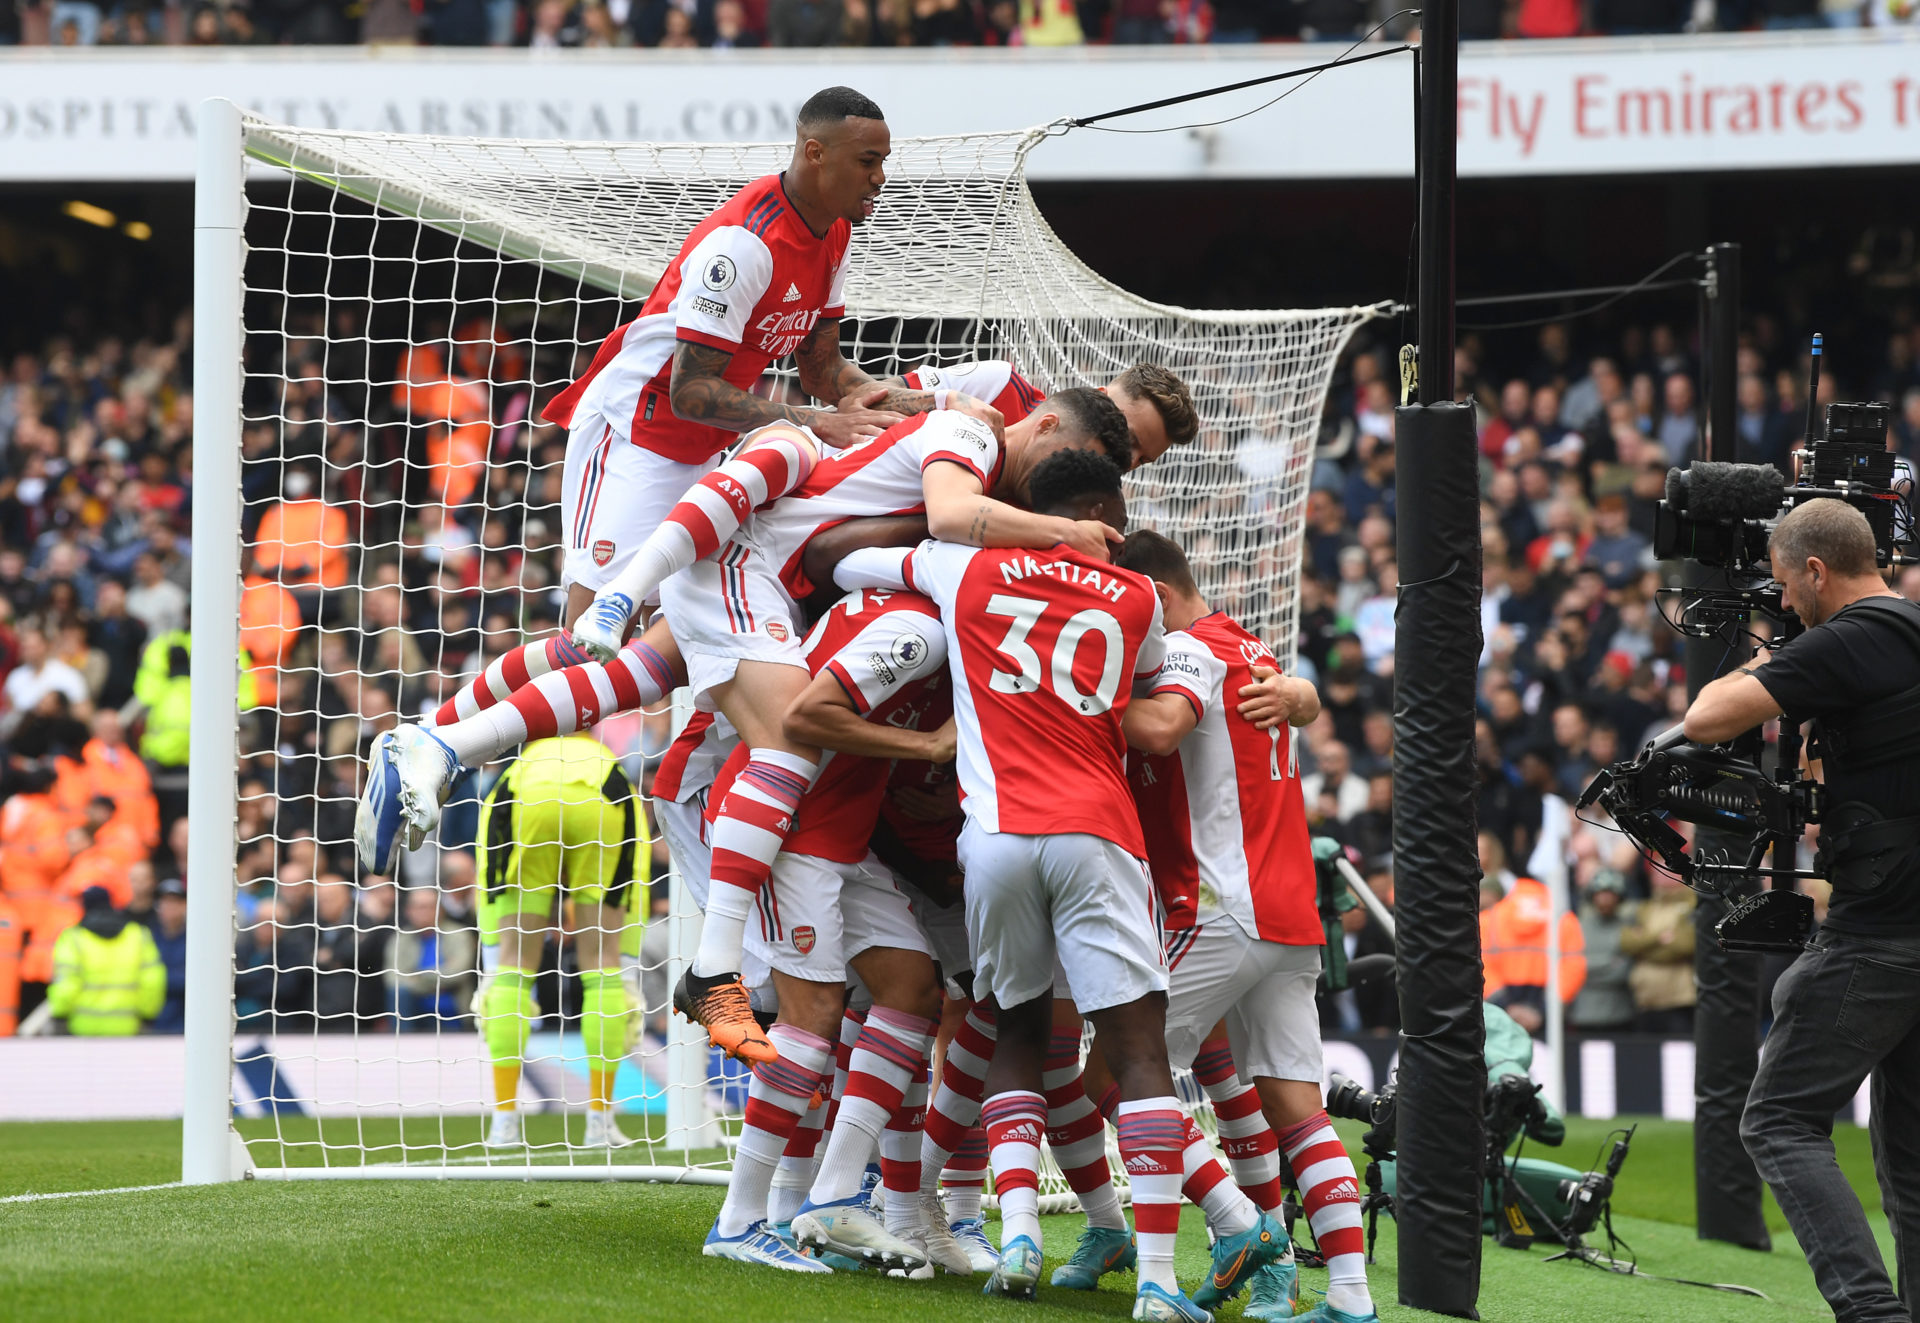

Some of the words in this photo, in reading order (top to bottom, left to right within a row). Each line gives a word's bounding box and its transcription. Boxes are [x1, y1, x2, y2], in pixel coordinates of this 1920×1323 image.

[1457, 73, 1545, 158] Fly
[1573, 71, 1864, 138] Emirates
[1892, 75, 1920, 129] t
[703, 299, 725, 312] room
[756, 306, 822, 334] Emirat
[717, 479, 747, 509] AFC
[999, 555, 1127, 603] NKETIAH
[985, 593, 1124, 716] 30
[1167, 653, 1189, 662] ISIT
[1729, 895, 1770, 926] STEADICAM
[1001, 1132, 1040, 1145] adidas
[1229, 1141, 1259, 1154] AFC
